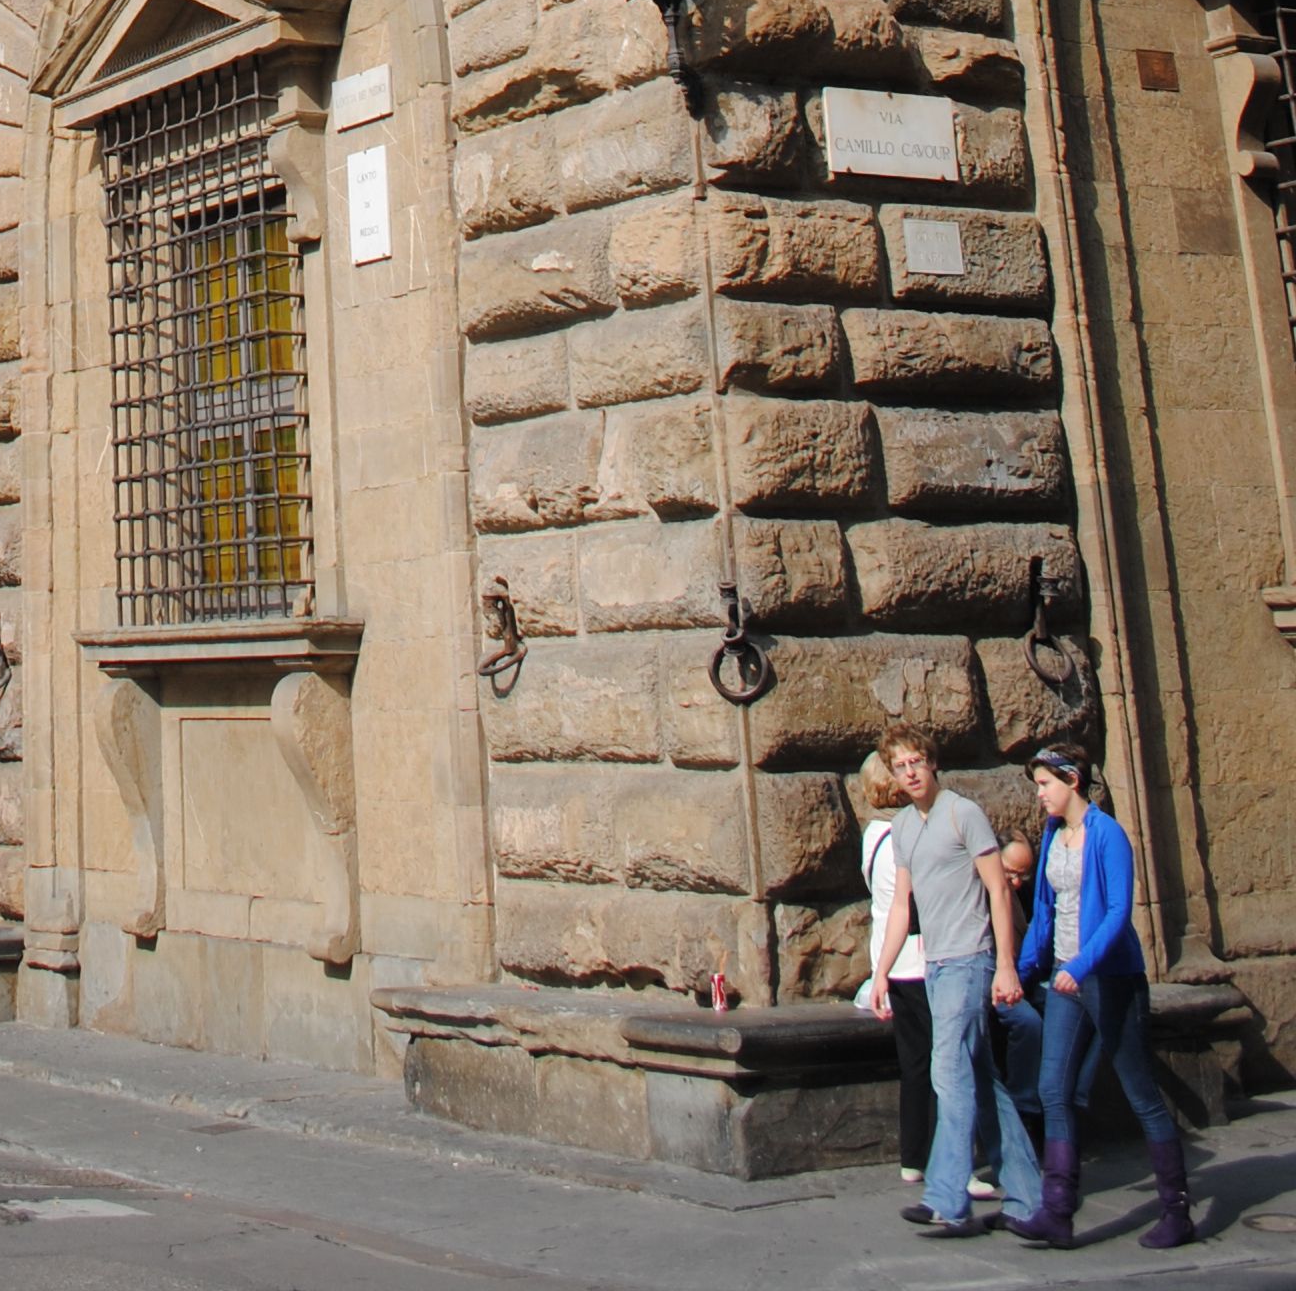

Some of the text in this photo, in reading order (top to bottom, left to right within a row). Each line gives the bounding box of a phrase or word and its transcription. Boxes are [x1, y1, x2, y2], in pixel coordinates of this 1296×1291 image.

[879, 111, 904, 125] VIA
[834, 136, 951, 160] CAMILLO CAVOUR
[356, 170, 377, 184] CANTO
